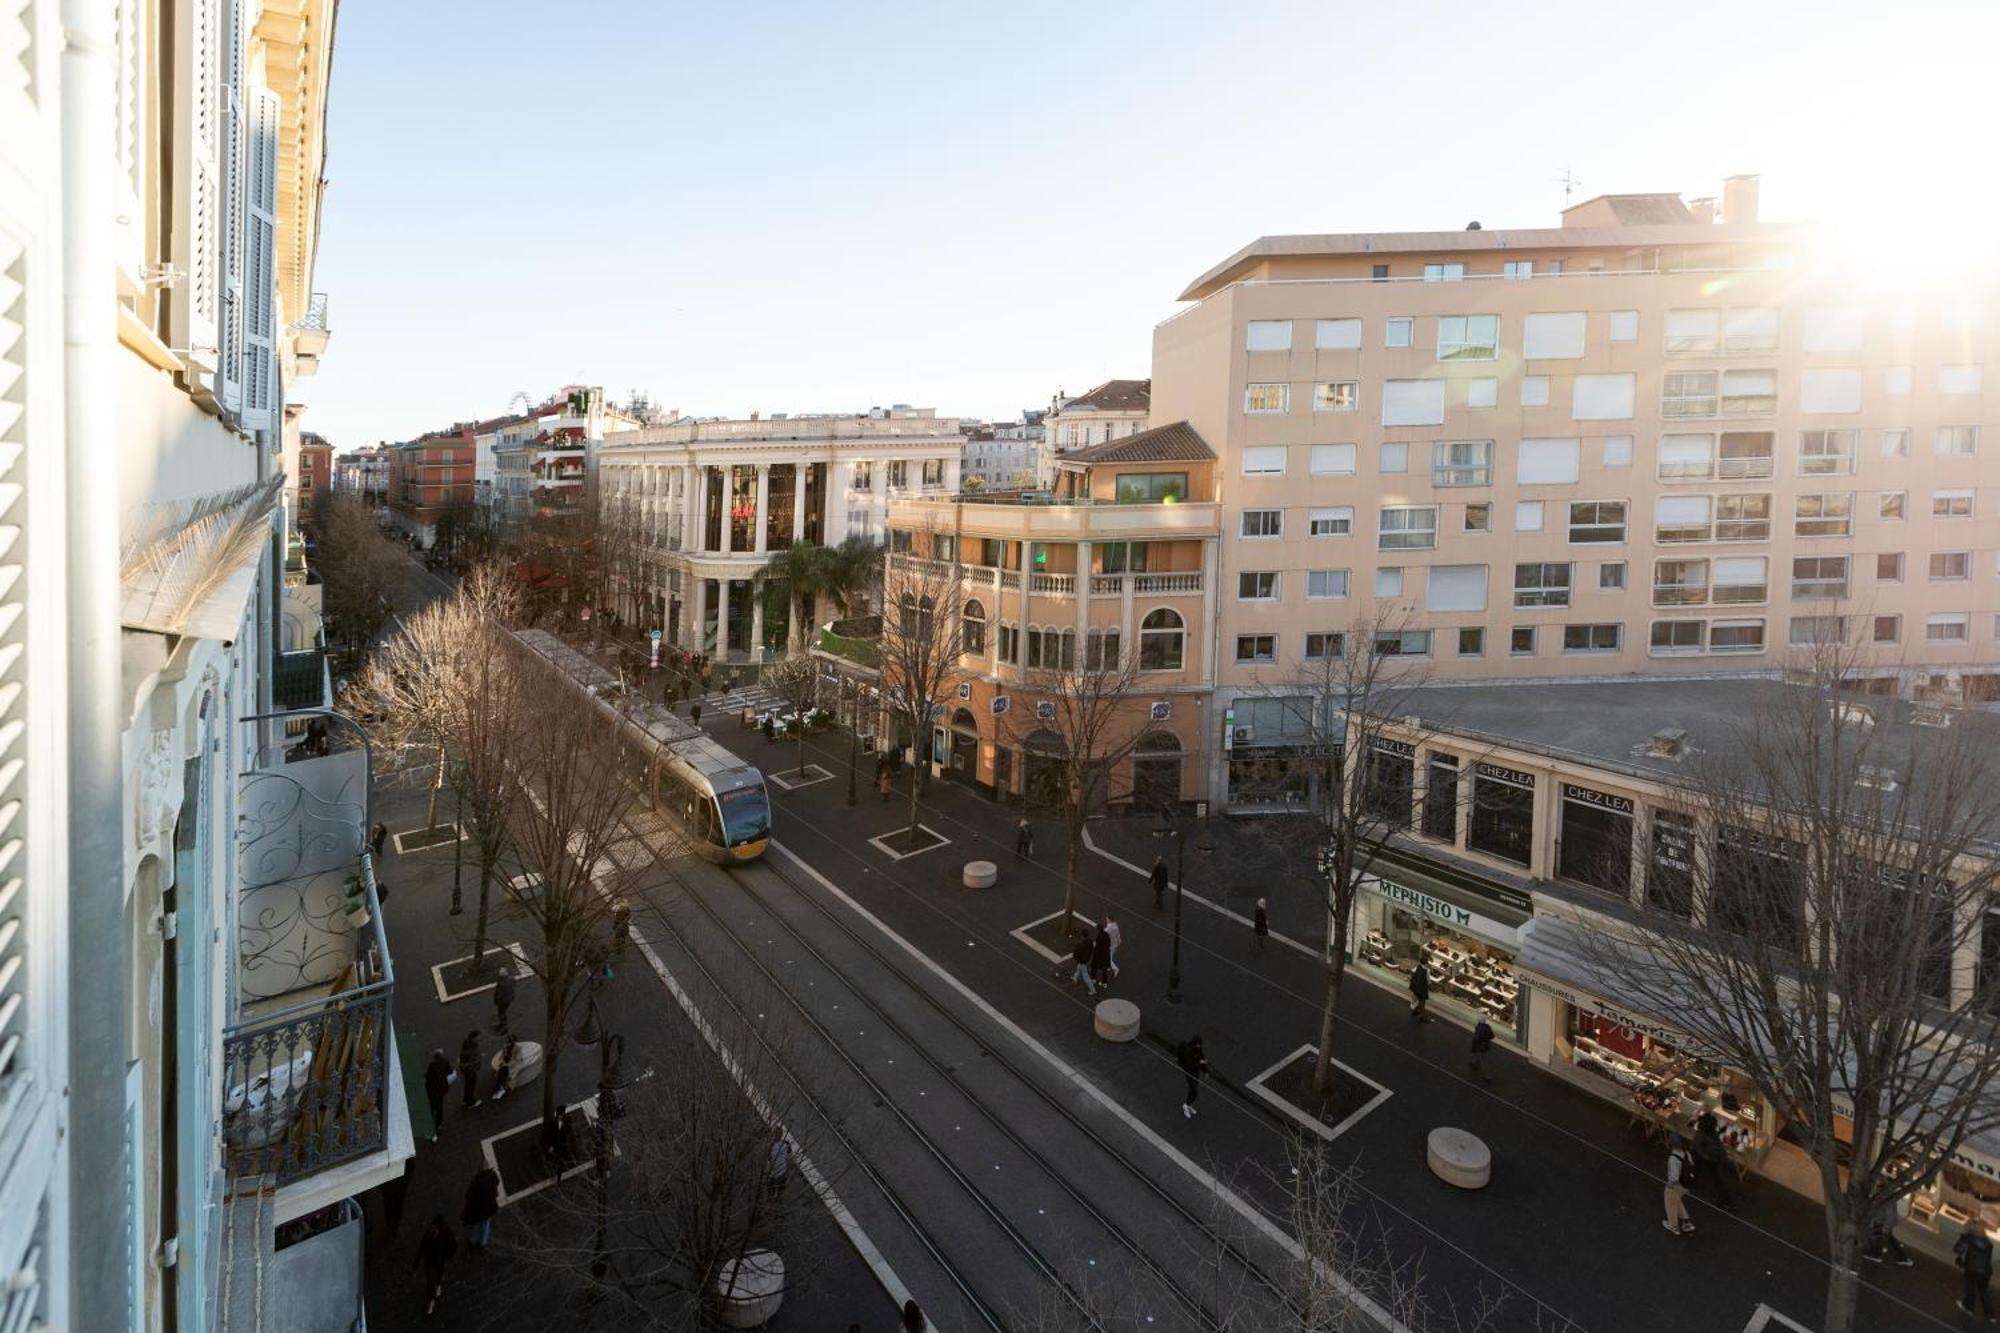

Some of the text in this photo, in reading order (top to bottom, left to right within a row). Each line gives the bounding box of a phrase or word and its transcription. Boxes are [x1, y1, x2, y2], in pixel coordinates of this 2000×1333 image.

[1479, 764, 1534, 786] CHEZ LEA
[1568, 786, 1631, 812] CHEZ LEA
[1379, 878, 1452, 919] MEPHISTO
[1518, 973, 1678, 1045] CHAUSSURES tamaris
